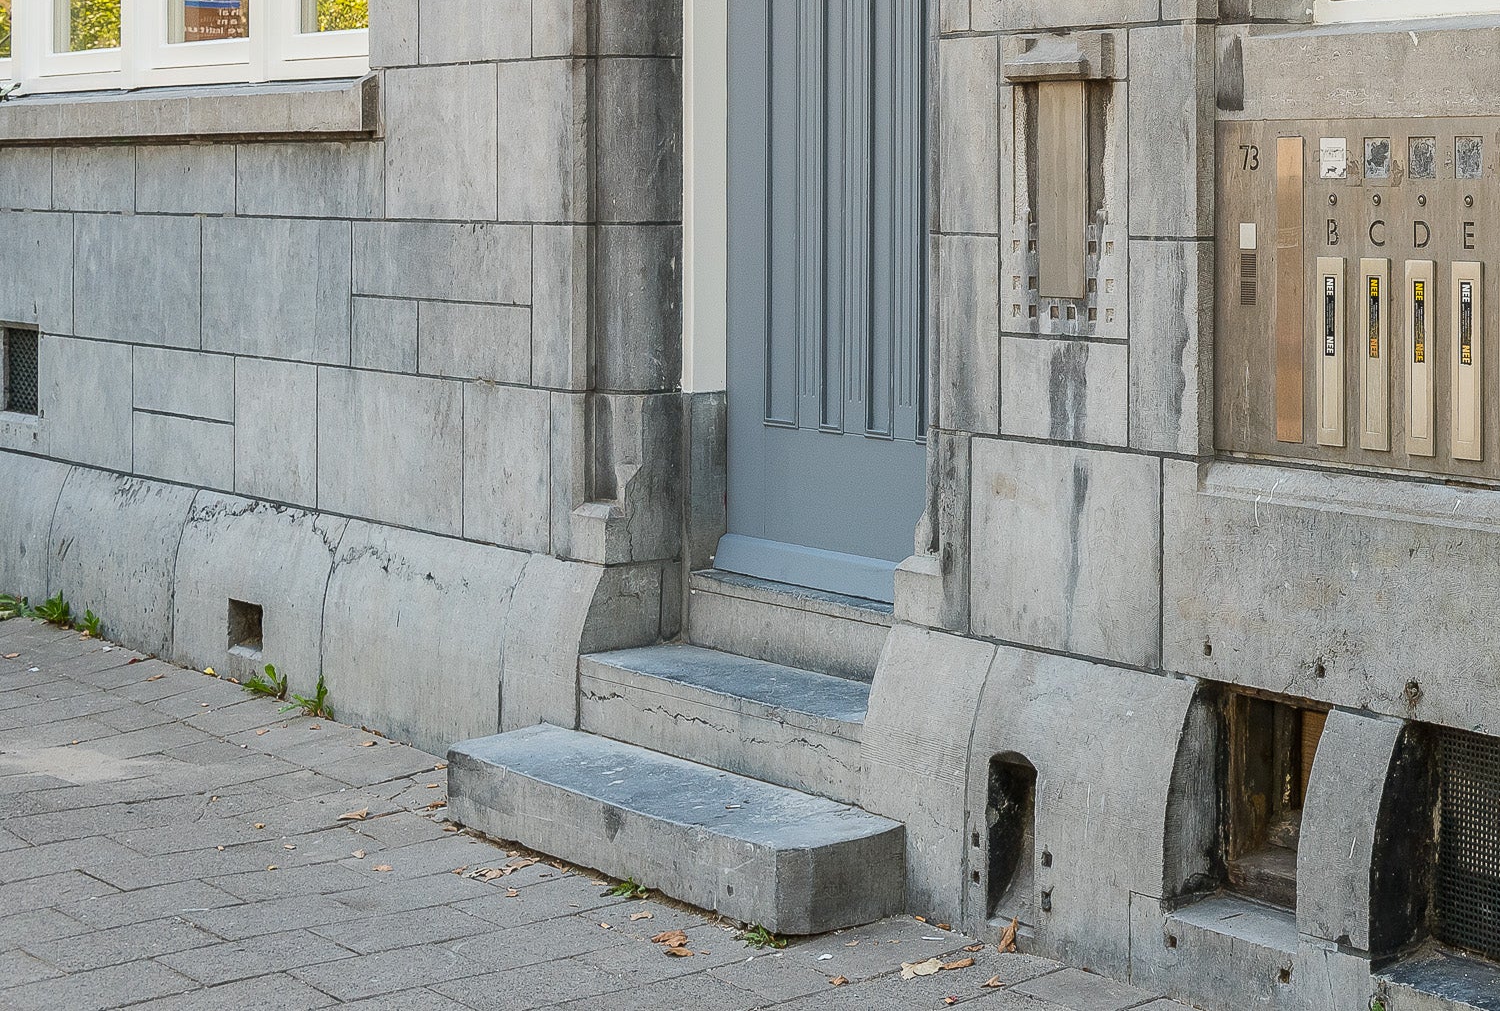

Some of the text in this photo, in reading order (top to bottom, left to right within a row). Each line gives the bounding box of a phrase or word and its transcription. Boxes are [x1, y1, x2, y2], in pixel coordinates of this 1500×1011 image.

[1239, 145, 1259, 171] 73
[1326, 219, 1340, 246] B
[1369, 220, 1385, 246] C
[1414, 220, 1430, 248] D
[1464, 222, 1474, 249] E
[1326, 278, 1334, 296] NEE
[1370, 279, 1378, 297] NEE
[1415, 283, 1424, 301] NEE
[1462, 284, 1470, 303] NEE
[1326, 336, 1334, 354] NEE
[1370, 338, 1379, 358] NEE
[1415, 343, 1424, 362] NEE
[1462, 345, 1471, 364] NEE
